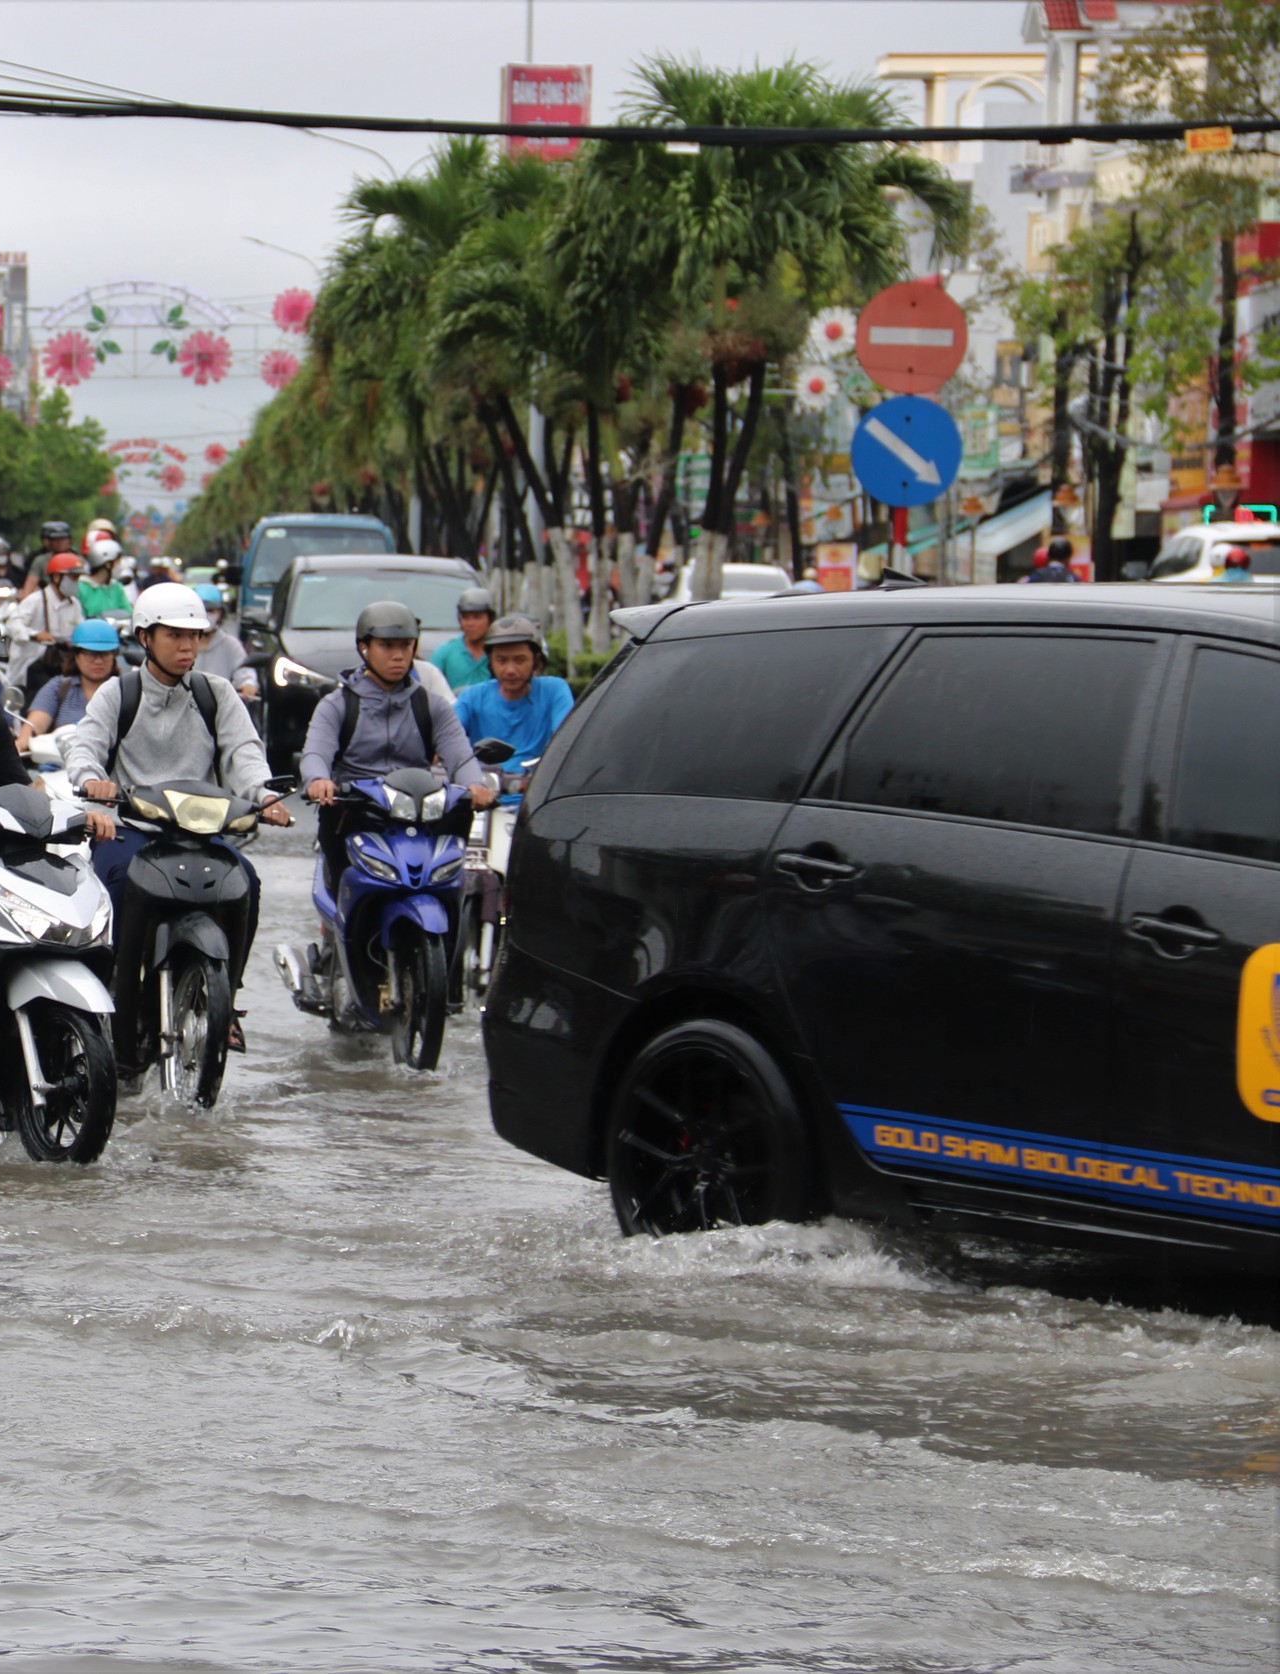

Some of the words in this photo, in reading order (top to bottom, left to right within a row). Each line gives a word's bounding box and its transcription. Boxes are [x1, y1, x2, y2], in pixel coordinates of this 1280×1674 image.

[874, 1124, 939, 1154] GOLD
[941, 1134, 1019, 1168] SHRIM
[1021, 1147, 1170, 1191] BIOLOGICAL
